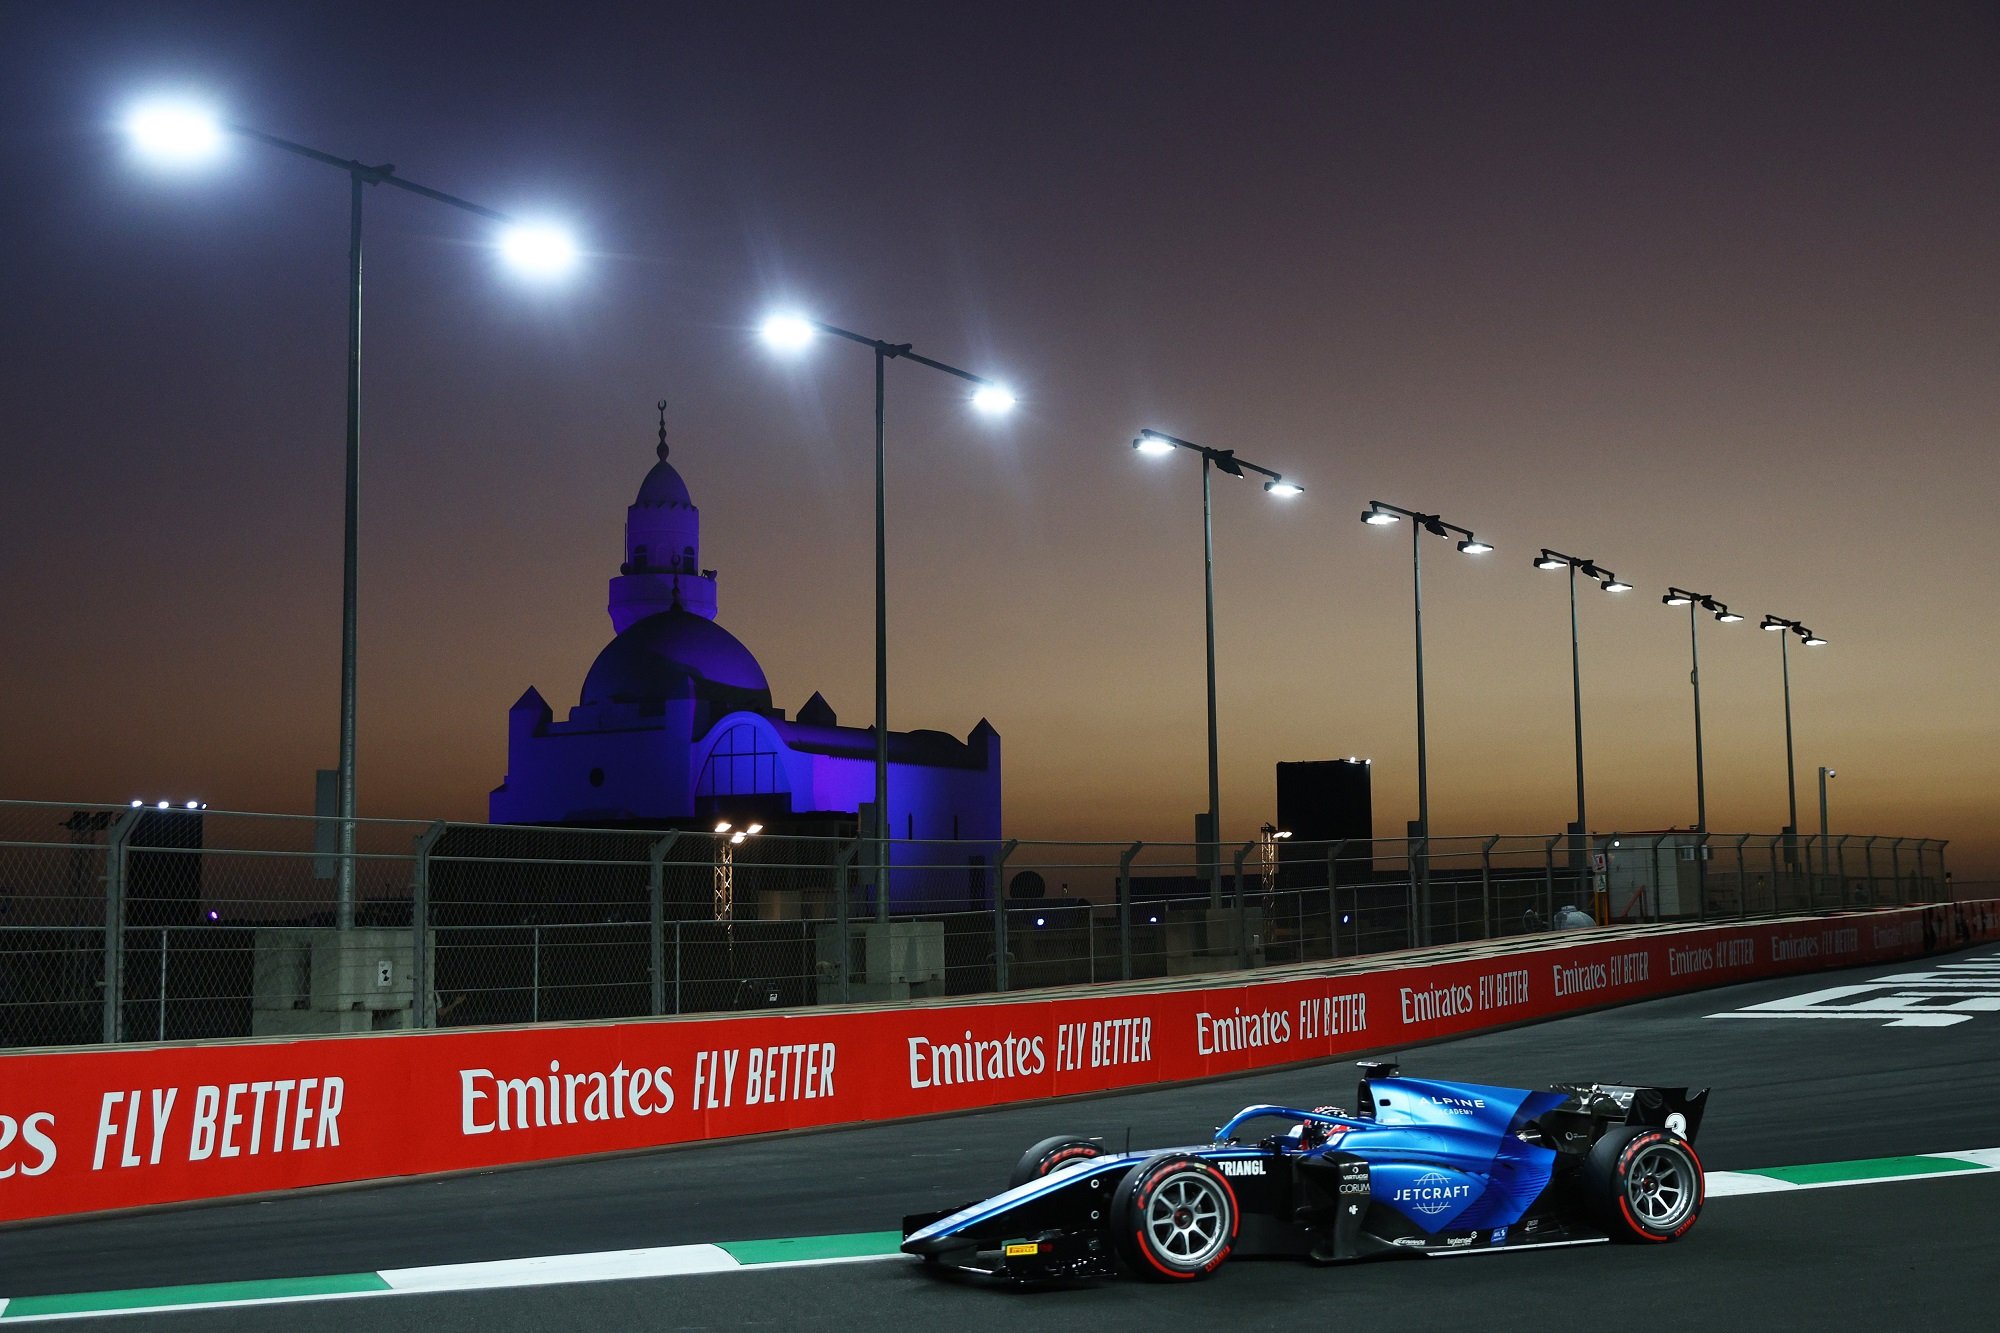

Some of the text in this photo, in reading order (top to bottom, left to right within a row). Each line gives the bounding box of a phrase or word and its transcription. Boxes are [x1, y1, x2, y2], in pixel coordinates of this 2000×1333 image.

[1553, 951, 1649, 997] Emirates FLY BETTER
[1669, 945, 1713, 977] Emirates
[1728, 938, 1754, 966] BETTER
[1400, 969, 1529, 1025] Emirates FLY BETTER
[1196, 992, 1367, 1055] Emirates FLY BETTER
[907, 1016, 1152, 1089] Emirates FLY BETTER
[460, 1042, 836, 1136] Emirates FLY BETTER
[1419, 1096, 1486, 1108] ALPINE
[92, 1088, 179, 1171] FLY
[189, 1076, 345, 1161] BETTER
[1217, 1160, 1266, 1176] TRIANGL
[1338, 1183, 1371, 1194] CORUM
[1342, 1173, 1369, 1181] VIRTUOSI
[1393, 1185, 1470, 1201] JETCRAFT
